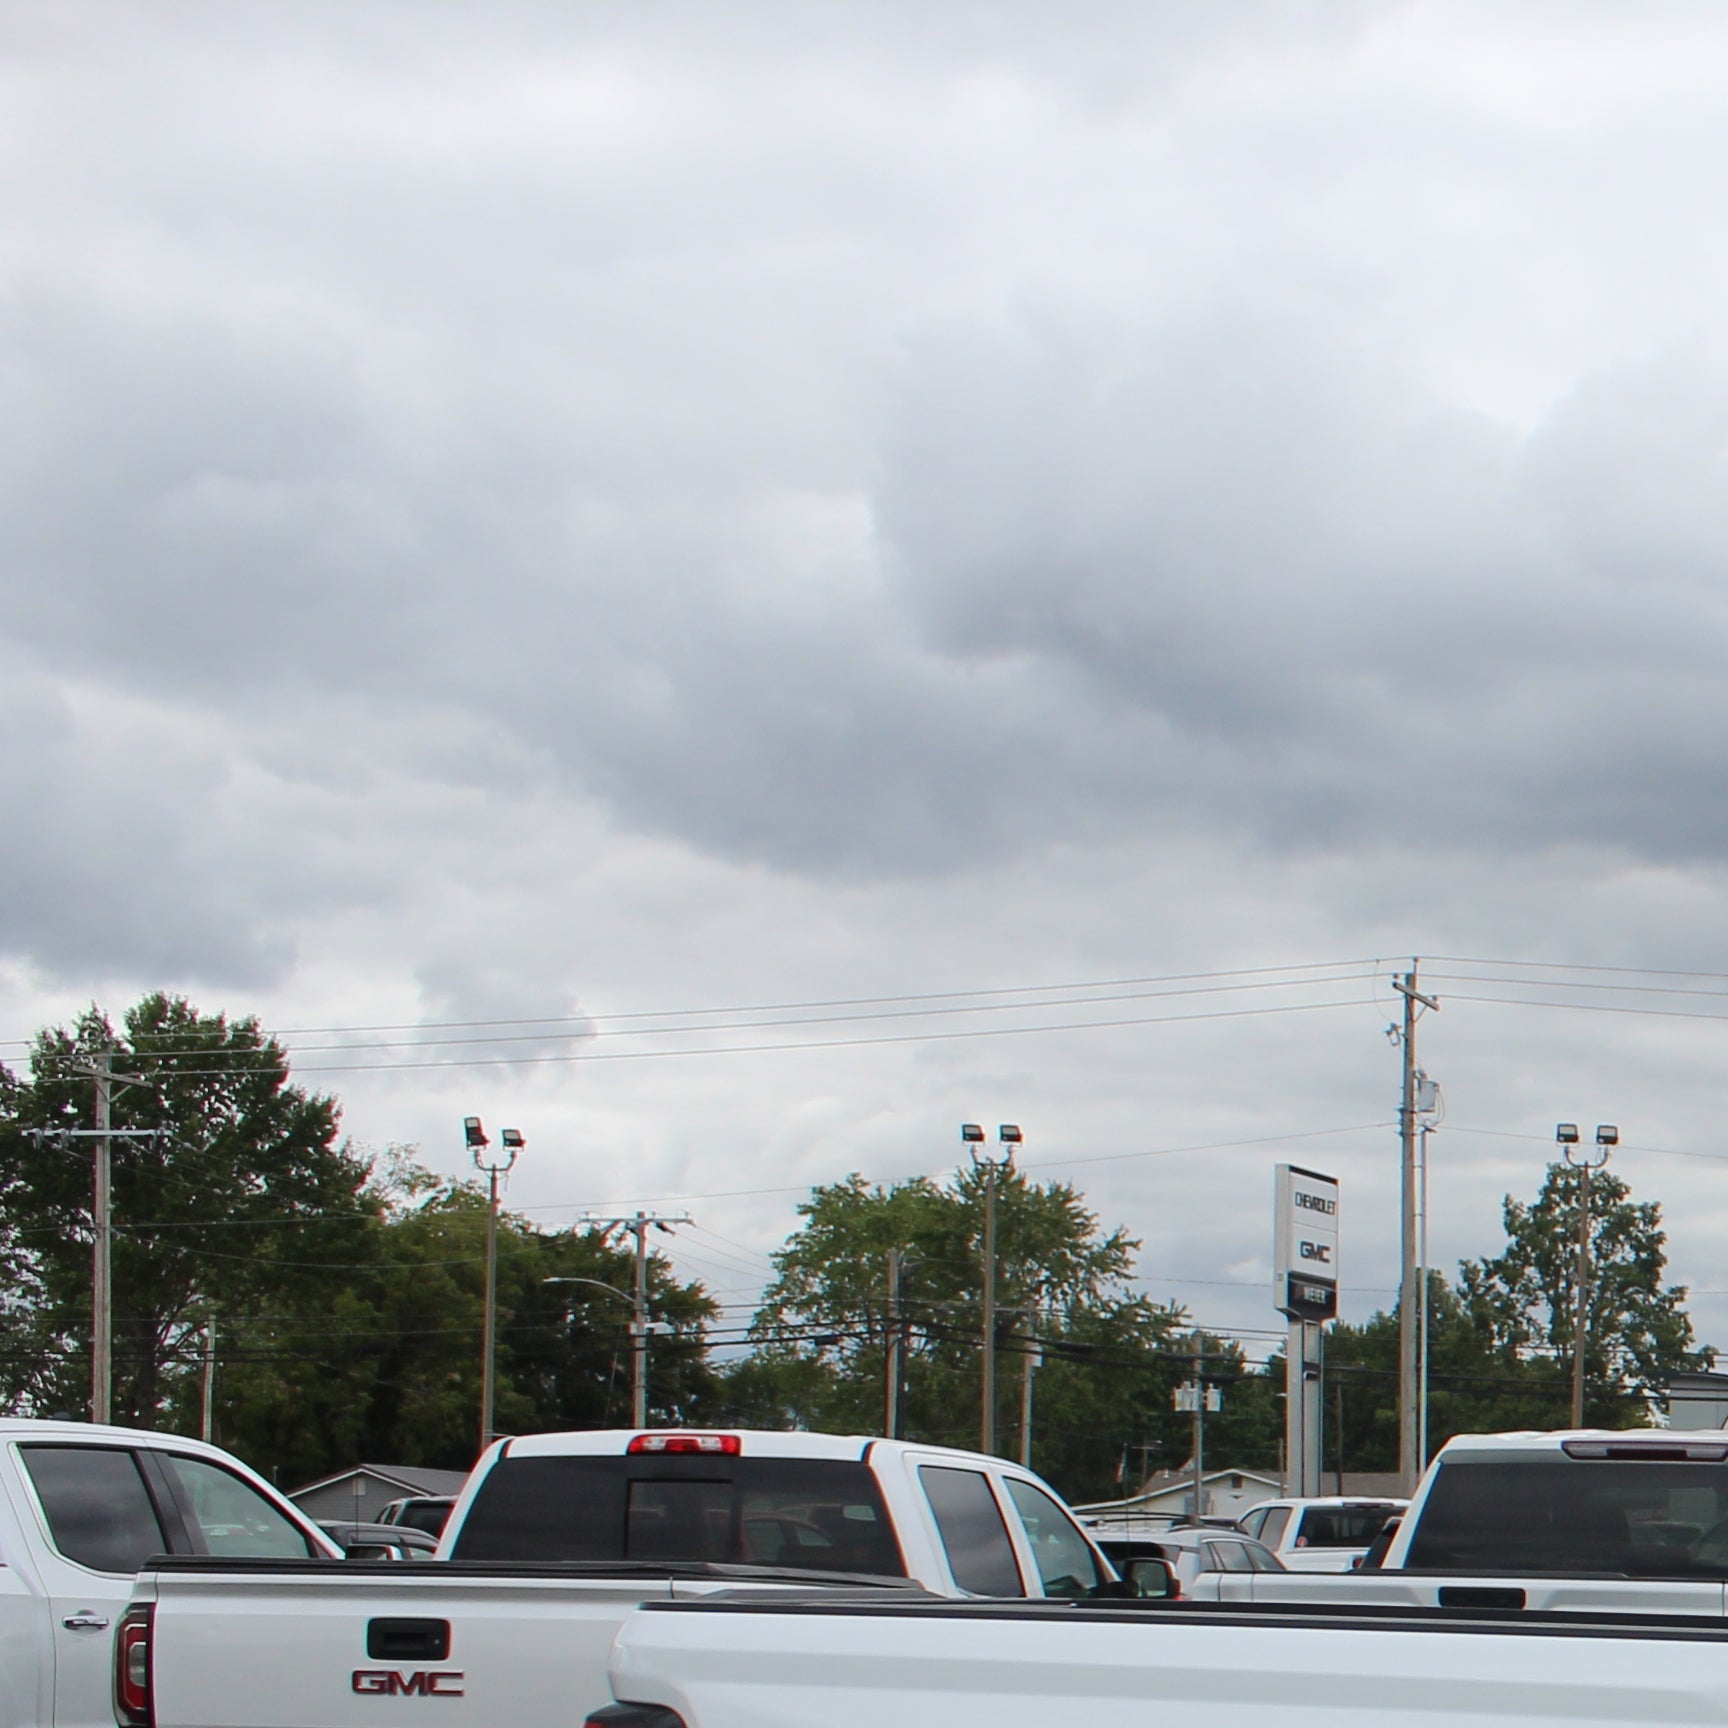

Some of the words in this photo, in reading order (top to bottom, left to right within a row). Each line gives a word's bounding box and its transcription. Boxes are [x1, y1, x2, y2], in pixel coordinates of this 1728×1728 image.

[1295, 1192, 1336, 1215] CHEVROLET
[1300, 1240, 1330, 1263] GMC
[352, 1669, 465, 1697] GMC
